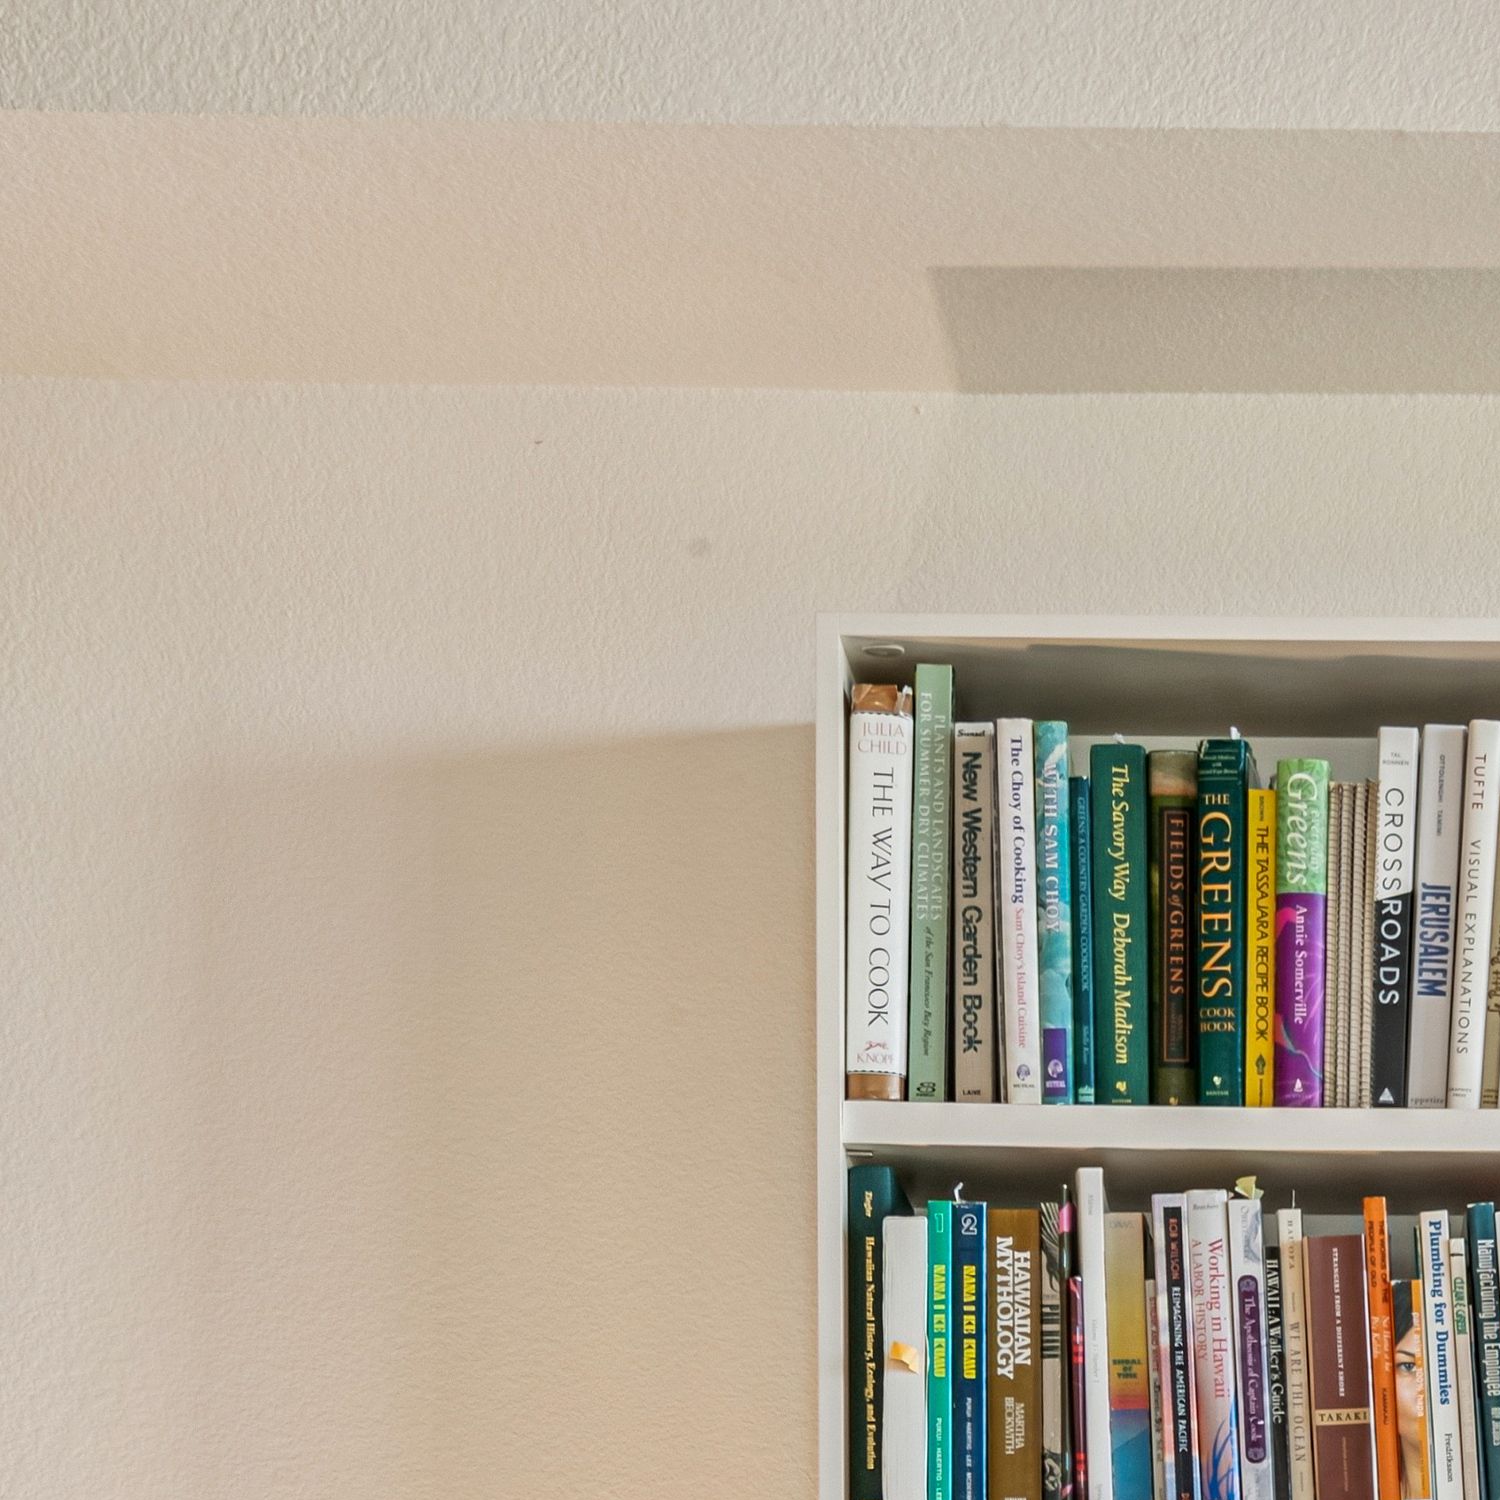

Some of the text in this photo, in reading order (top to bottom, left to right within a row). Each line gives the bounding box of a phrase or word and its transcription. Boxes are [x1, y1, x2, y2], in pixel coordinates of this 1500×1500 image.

[917, 692, 931, 920] FOR SUMMER-DRY CLIMATES
[931, 715, 946, 920] PLANTS AND LANDSCAPES
[1009, 736, 1027, 903] The Choy of Cooking
[1204, 794, 1230, 805] THE
[1285, 772, 1317, 884] Greens
[867, 767, 894, 1027] THE WAY TO COOK
[962, 752, 983, 1053] New Western Garden Book
[1108, 765, 1132, 1063] The Savory Way Deborah Madison
[1168, 819, 1184, 995] FIELDS of GREENS
[1200, 811, 1232, 998] GREENS
[1256, 827, 1270, 1041] THE TASSAJARA RECIPE BOOK
[1294, 904, 1307, 1024] Annie Somerville
[1417, 883, 1452, 997] JERUSALEM
[1455, 754, 1486, 1054] TUFTE VISUAL EXPLANATIONS
[1200, 1008, 1236, 1018] COOK
[1200, 1022, 1236, 1032] BOOK
[996, 1236, 1014, 1379] MYTHOLOGY
[1014, 1251, 1031, 1366] HAWAIIAN
[1208, 1238, 1224, 1310] Working
[1212, 1317, 1225, 1333] in
[1477, 1239, 1497, 1318] Manufacturing
[1483, 1322, 1498, 1339] the
[1428, 1220, 1455, 1482] Plumbing for Dummies Fredriksson
